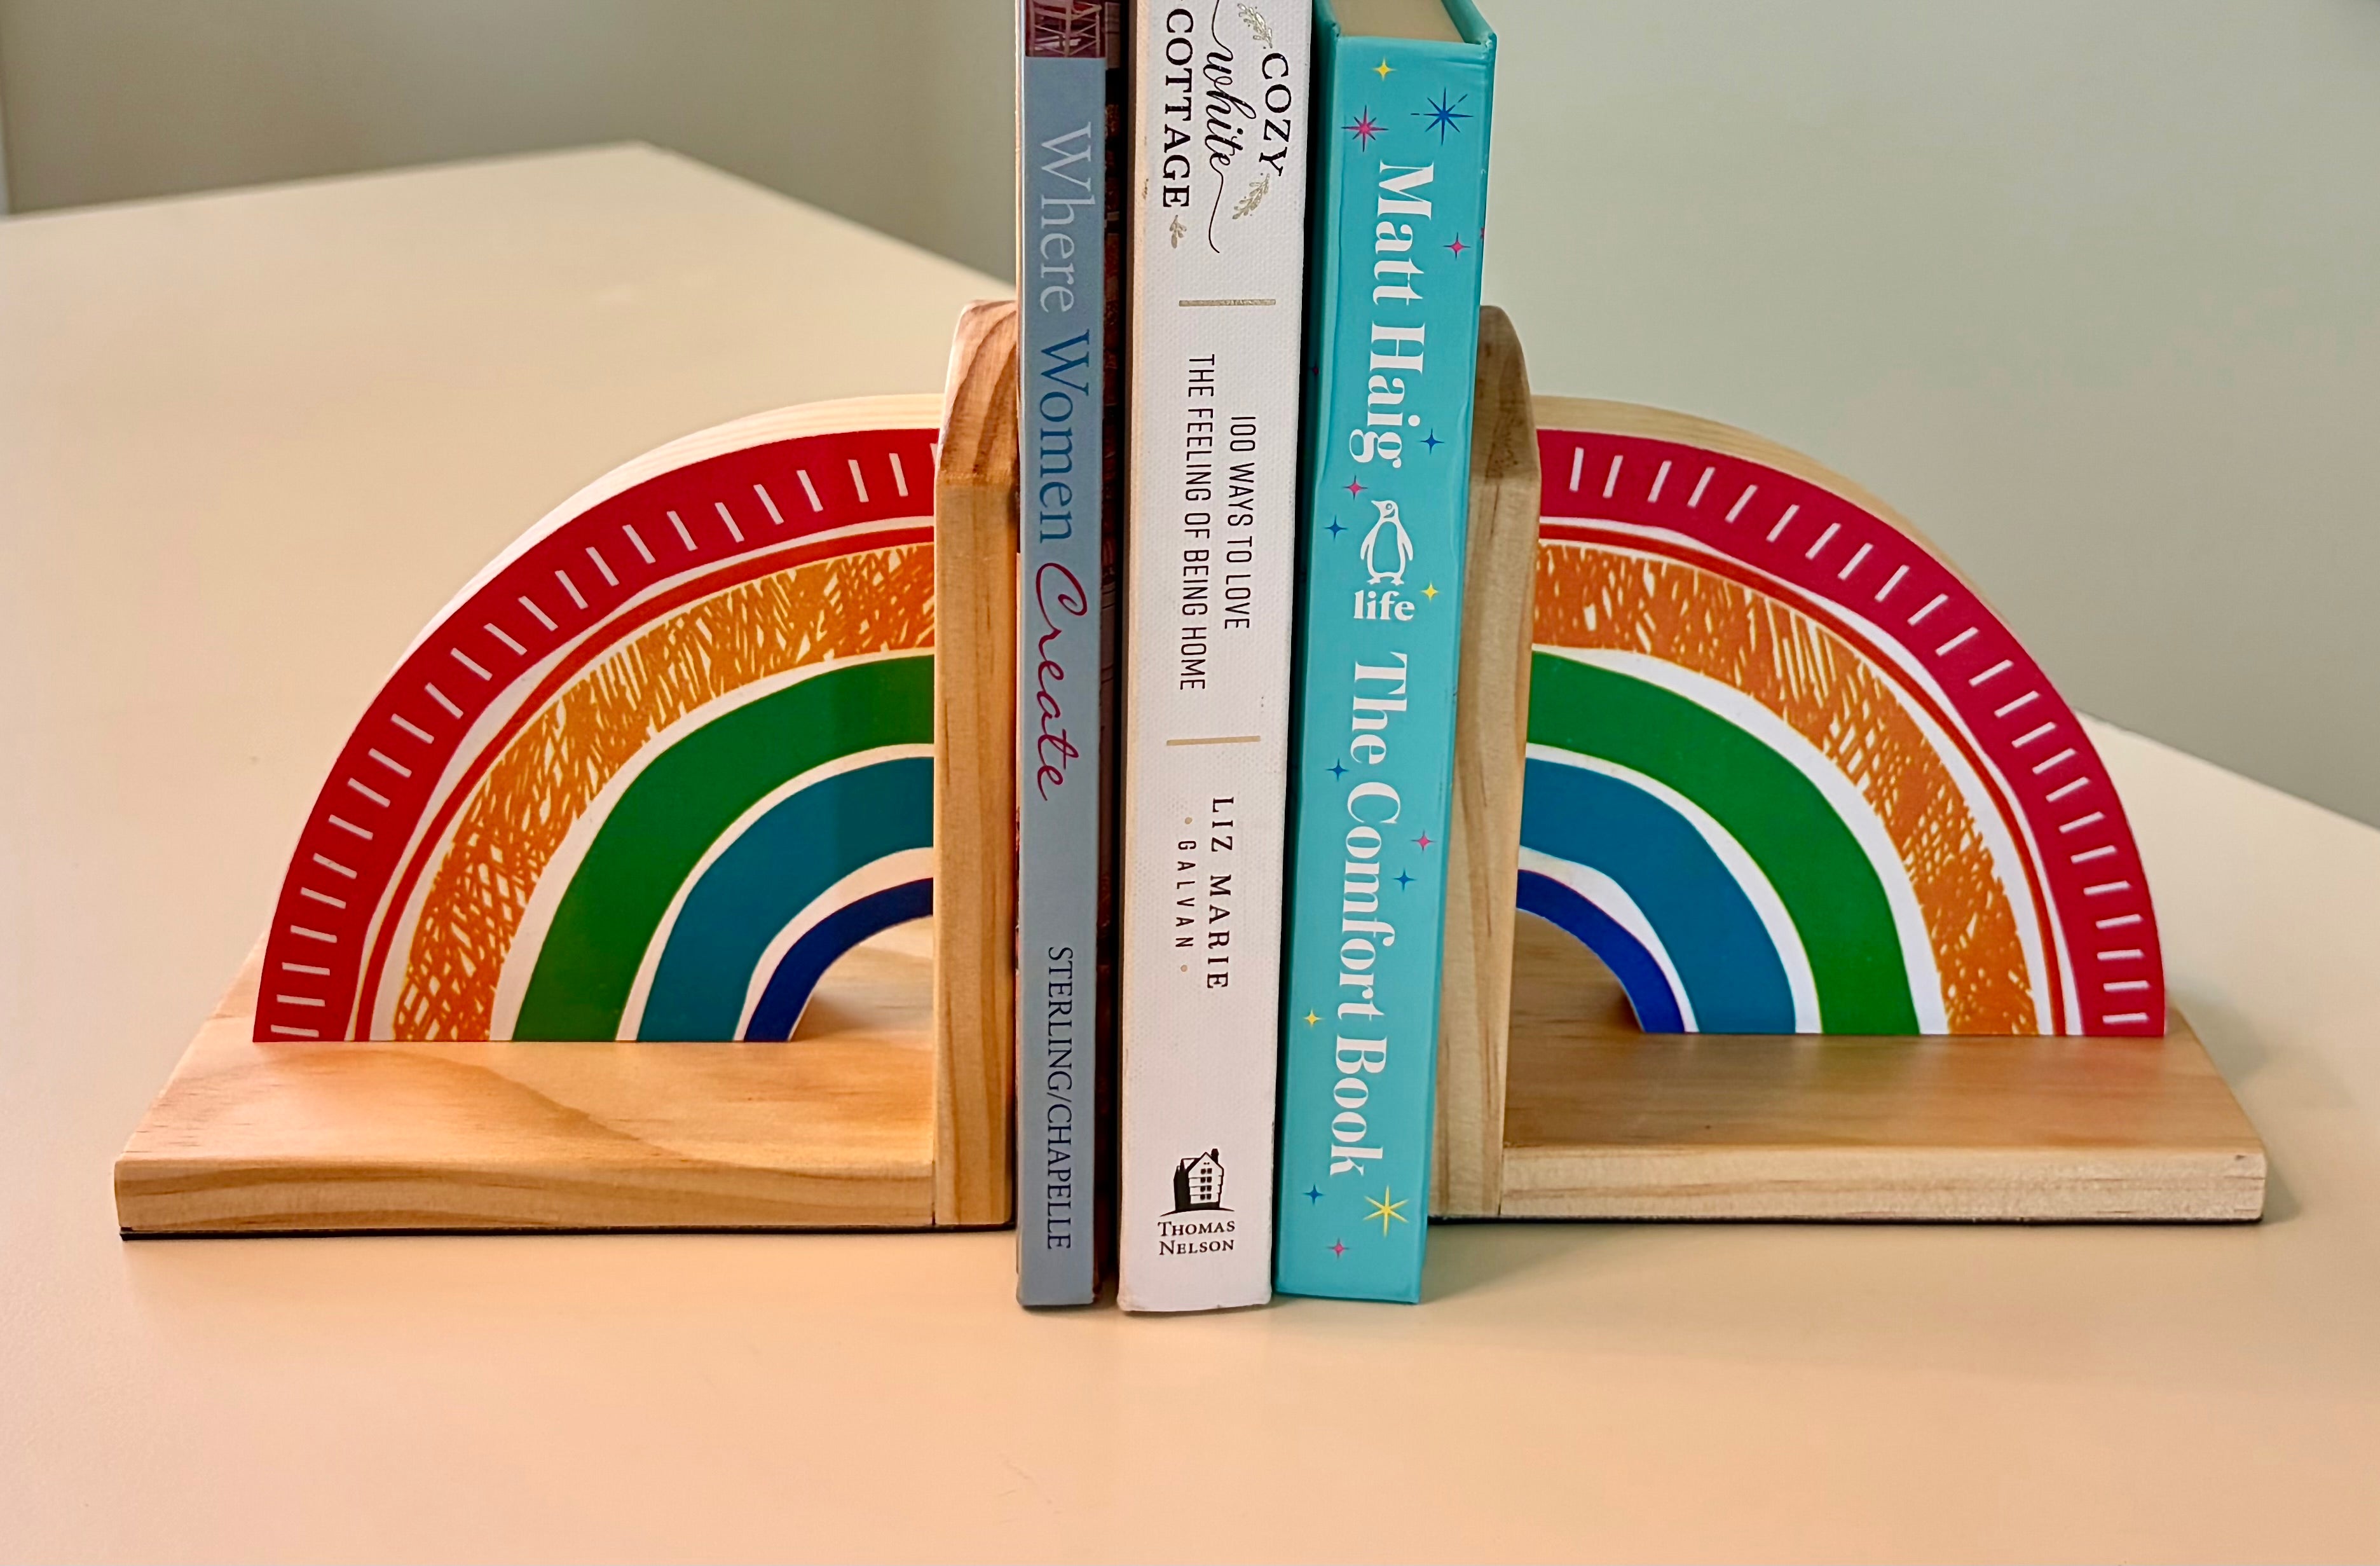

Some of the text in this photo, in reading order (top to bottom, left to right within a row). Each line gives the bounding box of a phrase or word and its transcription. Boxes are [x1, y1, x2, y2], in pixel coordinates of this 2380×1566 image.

[1162, 9, 1194, 208] COTTAGE
[1203, 38, 1256, 179] white
[1259, 53, 1292, 176] COZY
[1349, 160, 1434, 468] Matt Haig
[1036, 121, 1095, 801] Where Women Create
[1180, 354, 1215, 690] THE FEELING OF BEING HOME
[1225, 416, 1255, 629] 100 WAYS TO LOVE
[1354, 590, 1414, 621] life
[1175, 841, 1196, 947] GALVAN
[1207, 797, 1234, 989] LIZ MARIE
[1330, 652, 1407, 1177] The Comfort Book
[1047, 946, 1074, 1250] STERLING/CHAPELLE
